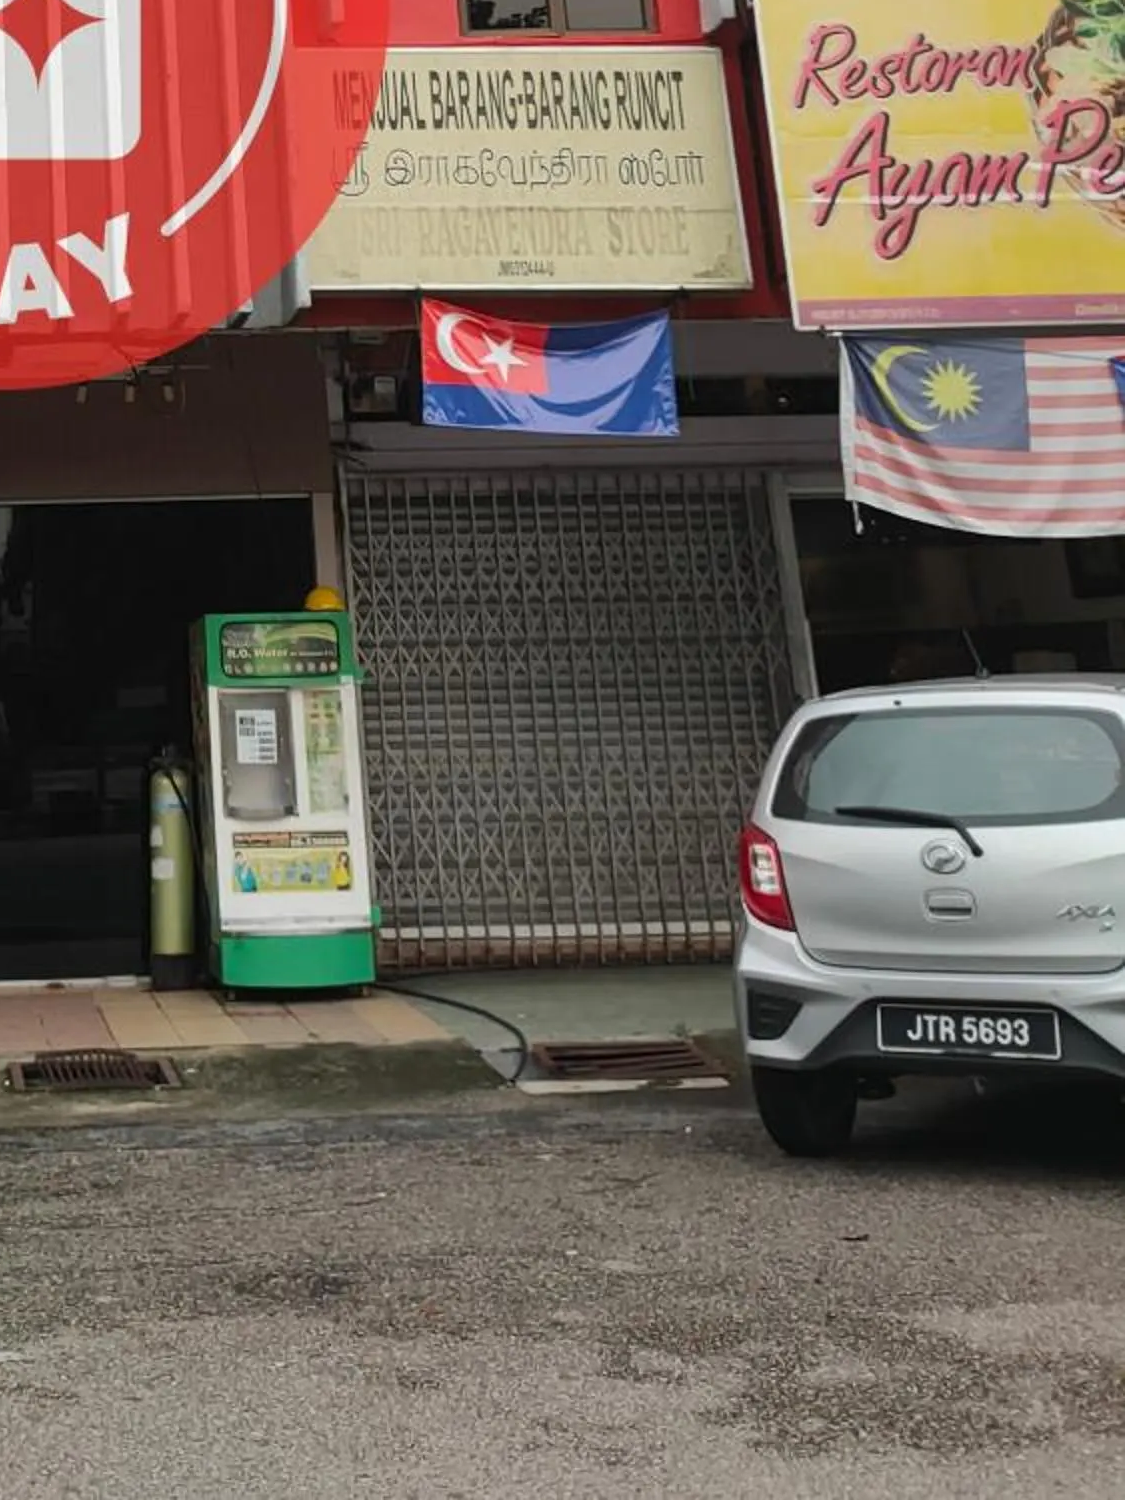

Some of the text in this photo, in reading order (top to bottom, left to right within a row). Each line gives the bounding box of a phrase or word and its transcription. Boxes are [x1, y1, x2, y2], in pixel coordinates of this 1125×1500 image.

[794, 23, 1040, 110] Restoran
[332, 69, 686, 131] MENJUAL BARANG-BARANG RUNCIT
[813, 112, 1029, 259] Ayam
[606, 206, 690, 257] STORE
[906, 1014, 1030, 1046] JTR 5693
